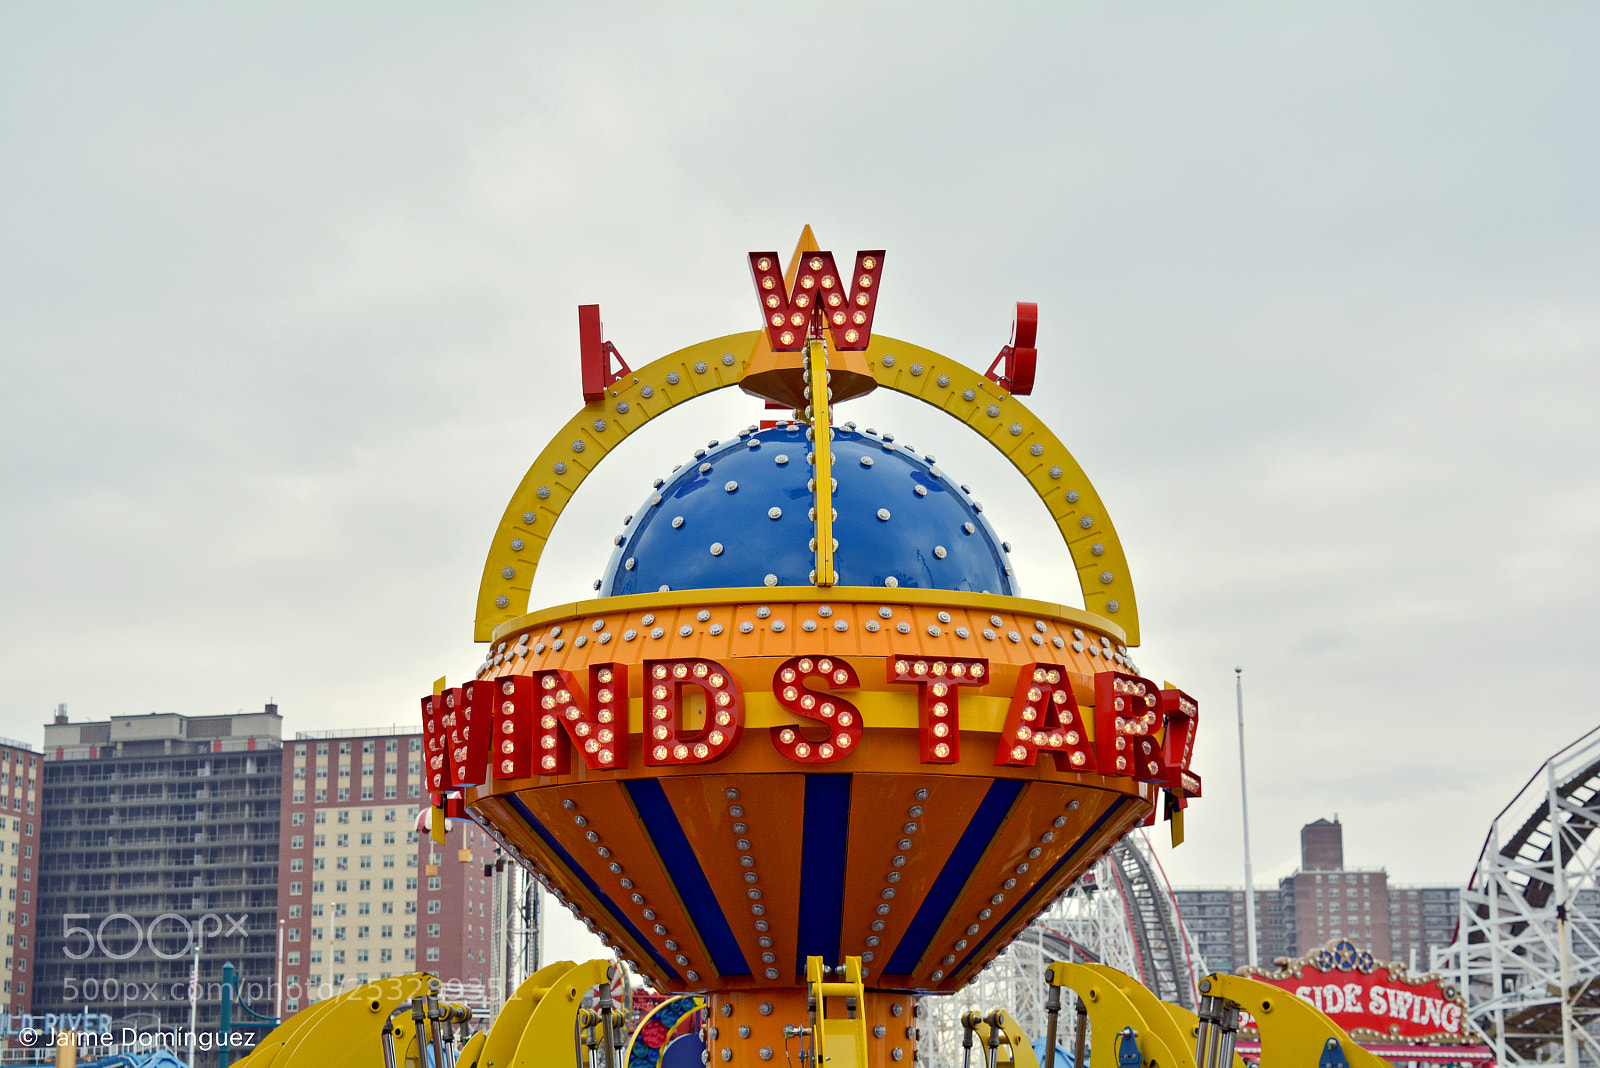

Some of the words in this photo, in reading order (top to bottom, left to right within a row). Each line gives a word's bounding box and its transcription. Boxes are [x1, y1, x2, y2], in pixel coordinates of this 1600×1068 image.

[748, 250, 886, 351] W
[44, 1013, 112, 1035] RIVER
[1369, 985, 1462, 1033] SWING
